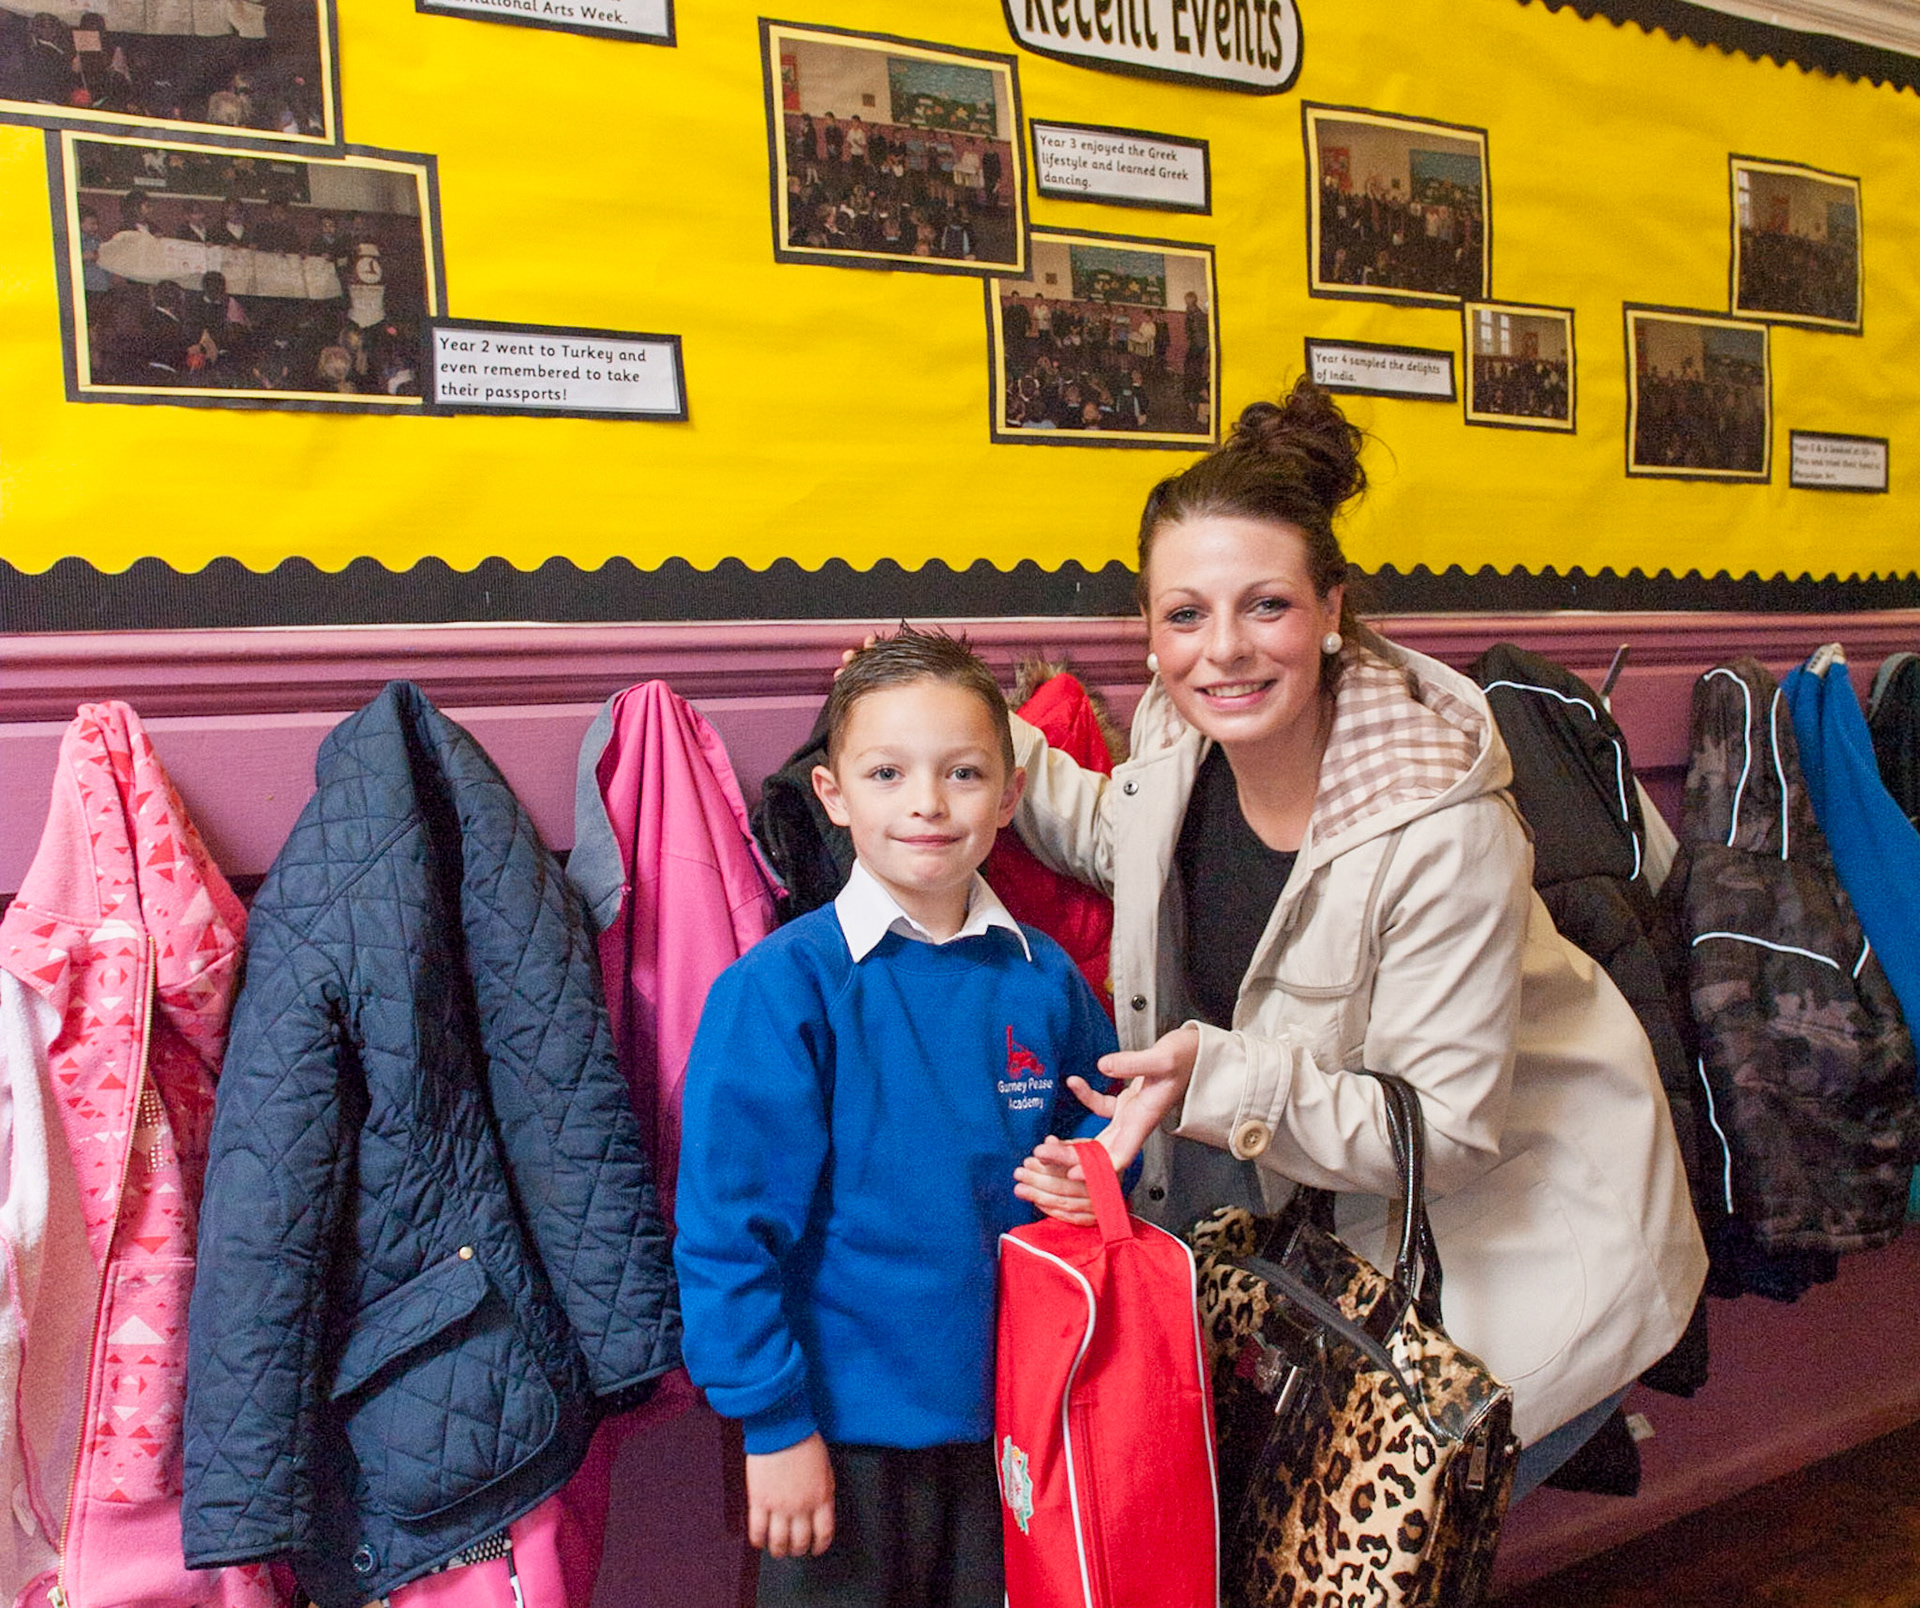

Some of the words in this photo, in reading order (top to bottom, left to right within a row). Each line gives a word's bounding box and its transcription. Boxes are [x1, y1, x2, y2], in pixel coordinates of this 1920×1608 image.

[543, 2, 574, 16] Arts
[580, 6, 628, 24] Week.
[1173, 0, 1283, 72] Events
[1040, 135, 1066, 148] Year
[1070, 138, 1076, 148] 3
[1081, 140, 1124, 156] enjoyed
[1128, 146, 1145, 157] the
[1149, 148, 1178, 162] Greek
[1042, 153, 1088, 170] lifestyle
[1092, 160, 1112, 171] and
[1117, 162, 1156, 177] learned
[1159, 167, 1188, 180] Greek
[1044, 172, 1092, 190] dancing.
[440, 337, 475, 352] Year
[481, 340, 490, 353] 2
[496, 343, 535, 356] went
[541, 342, 555, 357] to
[562, 345, 613, 363] Turkey
[619, 349, 646, 362] and
[440, 363, 477, 374] even
[484, 364, 580, 380] remembered
[586, 368, 601, 380] to
[608, 369, 640, 382] take
[1316, 353, 1338, 364] Year
[1342, 354, 1347, 364] 4
[1350, 356, 1386, 370] sampled
[1389, 359, 1404, 370] the
[1406, 362, 1440, 375] delights
[1317, 369, 1326, 382] of
[1330, 371, 1356, 382] India.
[441, 383, 479, 397] their
[486, 386, 567, 402] passports!
[997, 1080, 1027, 1094] Gurney
[1028, 1077, 1053, 1090] Pease
[1008, 1096, 1044, 1110] Academy
